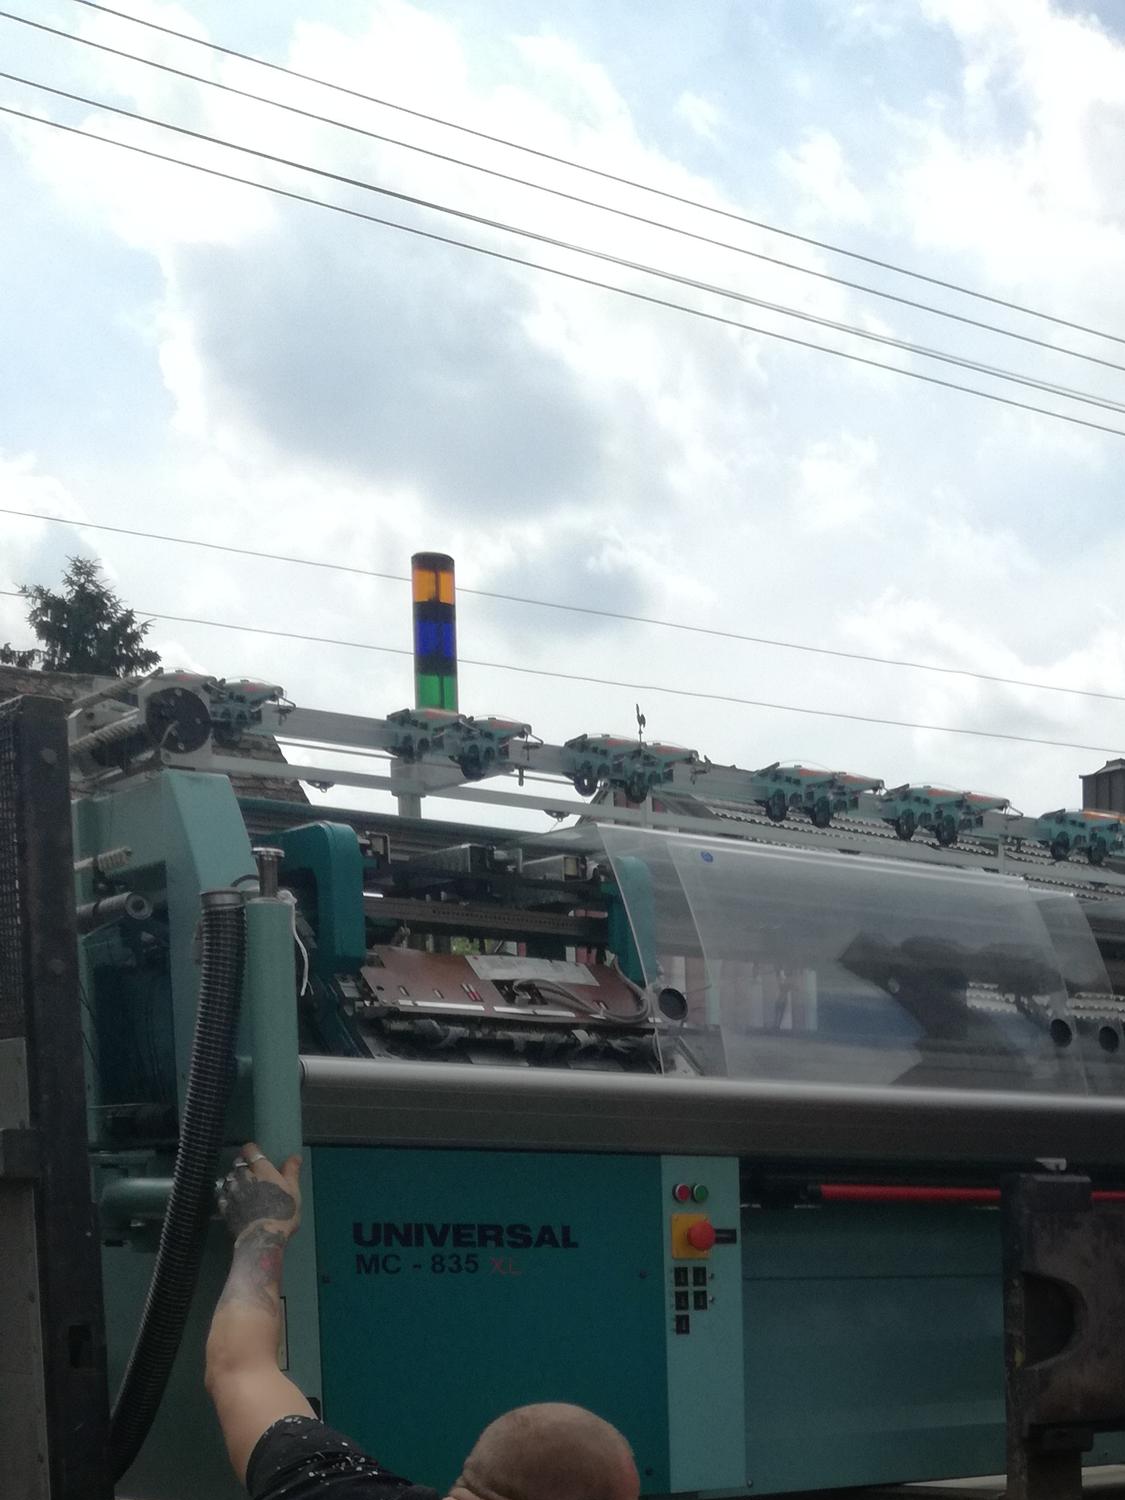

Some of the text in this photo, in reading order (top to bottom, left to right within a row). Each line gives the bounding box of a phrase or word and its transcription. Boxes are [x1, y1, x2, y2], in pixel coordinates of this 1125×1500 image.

[352, 1222, 578, 1249] UNIVERSAL
[355, 1253, 401, 1275] MC
[430, 1253, 480, 1275] 835
